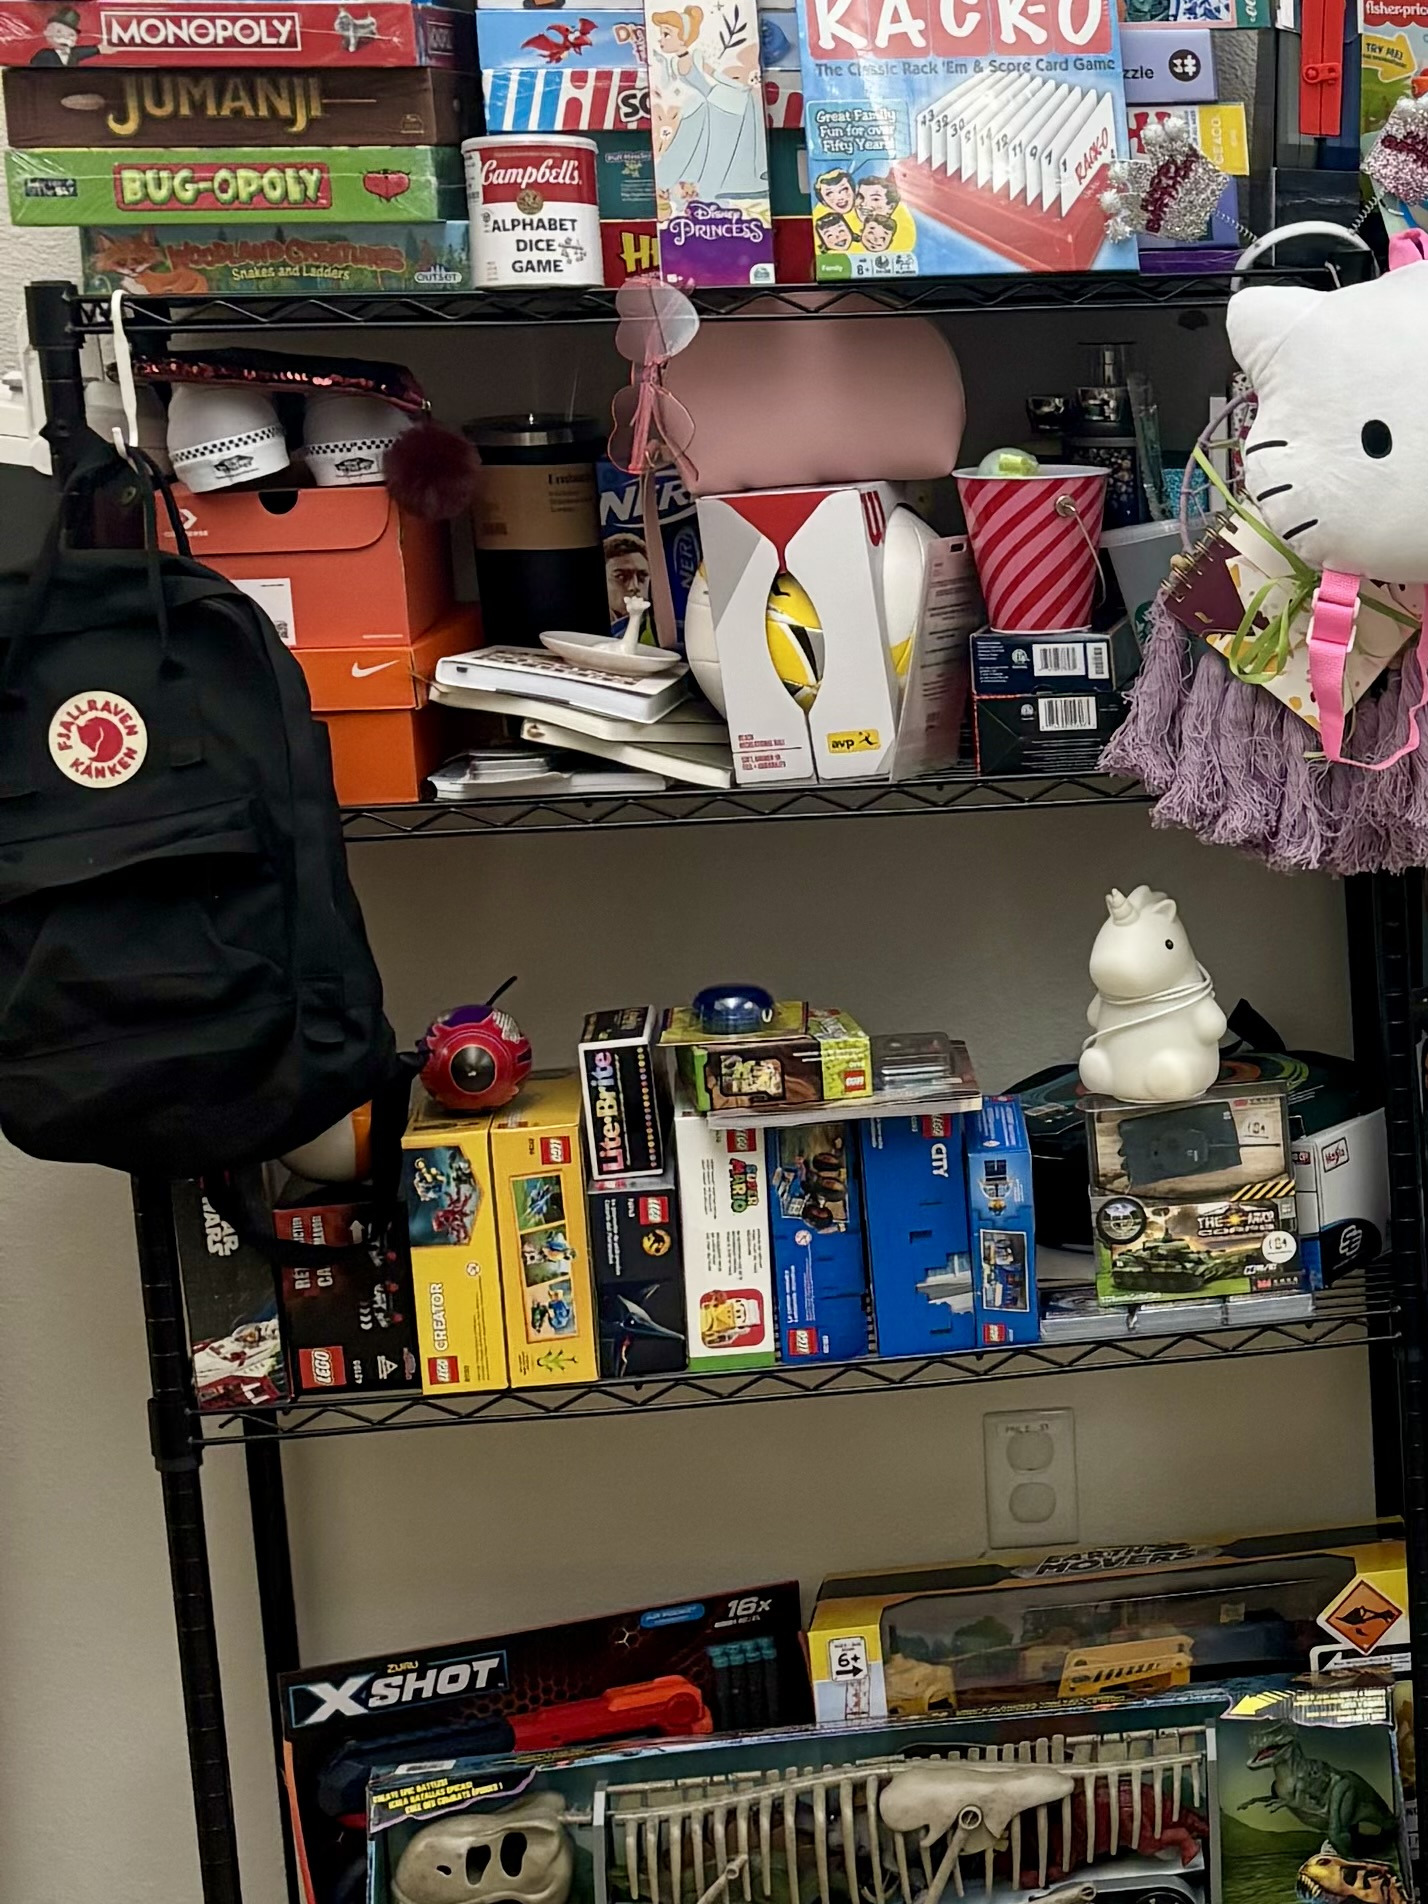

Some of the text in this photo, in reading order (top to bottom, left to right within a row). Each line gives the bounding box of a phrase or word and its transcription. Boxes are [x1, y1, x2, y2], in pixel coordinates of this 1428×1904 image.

[111, 16, 292, 47] MONOPOLY
[1366, 42, 1386, 54] TRY
[815, 56, 1116, 78] The Classic Rack 'Em & Score Card Game
[107, 74, 324, 136] JUMANJI
[815, 107, 897, 127] Great Family
[820, 122, 896, 139] Fun for over
[823, 138, 851, 156] Fifty
[482, 158, 583, 188] Campbell's
[121, 166, 323, 206] BUG-OPOLY
[691, 203, 744, 220] Disney
[491, 218, 578, 234] ALPHABET
[669, 220, 764, 246] PRINCESS
[516, 238, 557, 254] DICE
[232, 262, 351, 283] Snakes and Ladders
[511, 259, 565, 275] GAME
[831, 738, 855, 750] avp
[547, 1139, 565, 1163] LEGO
[929, 1142, 948, 1178] CITY
[729, 1158, 748, 1214] MARIO
[433, 1282, 446, 1352] CREATOR
[314, 1349, 334, 1385] LEGO
[435, 1359, 450, 1382] LEGO
[728, 1597, 773, 1618] 16x
[387, 1659, 420, 1674] ZURU
[838, 1652, 862, 1669] 6+
